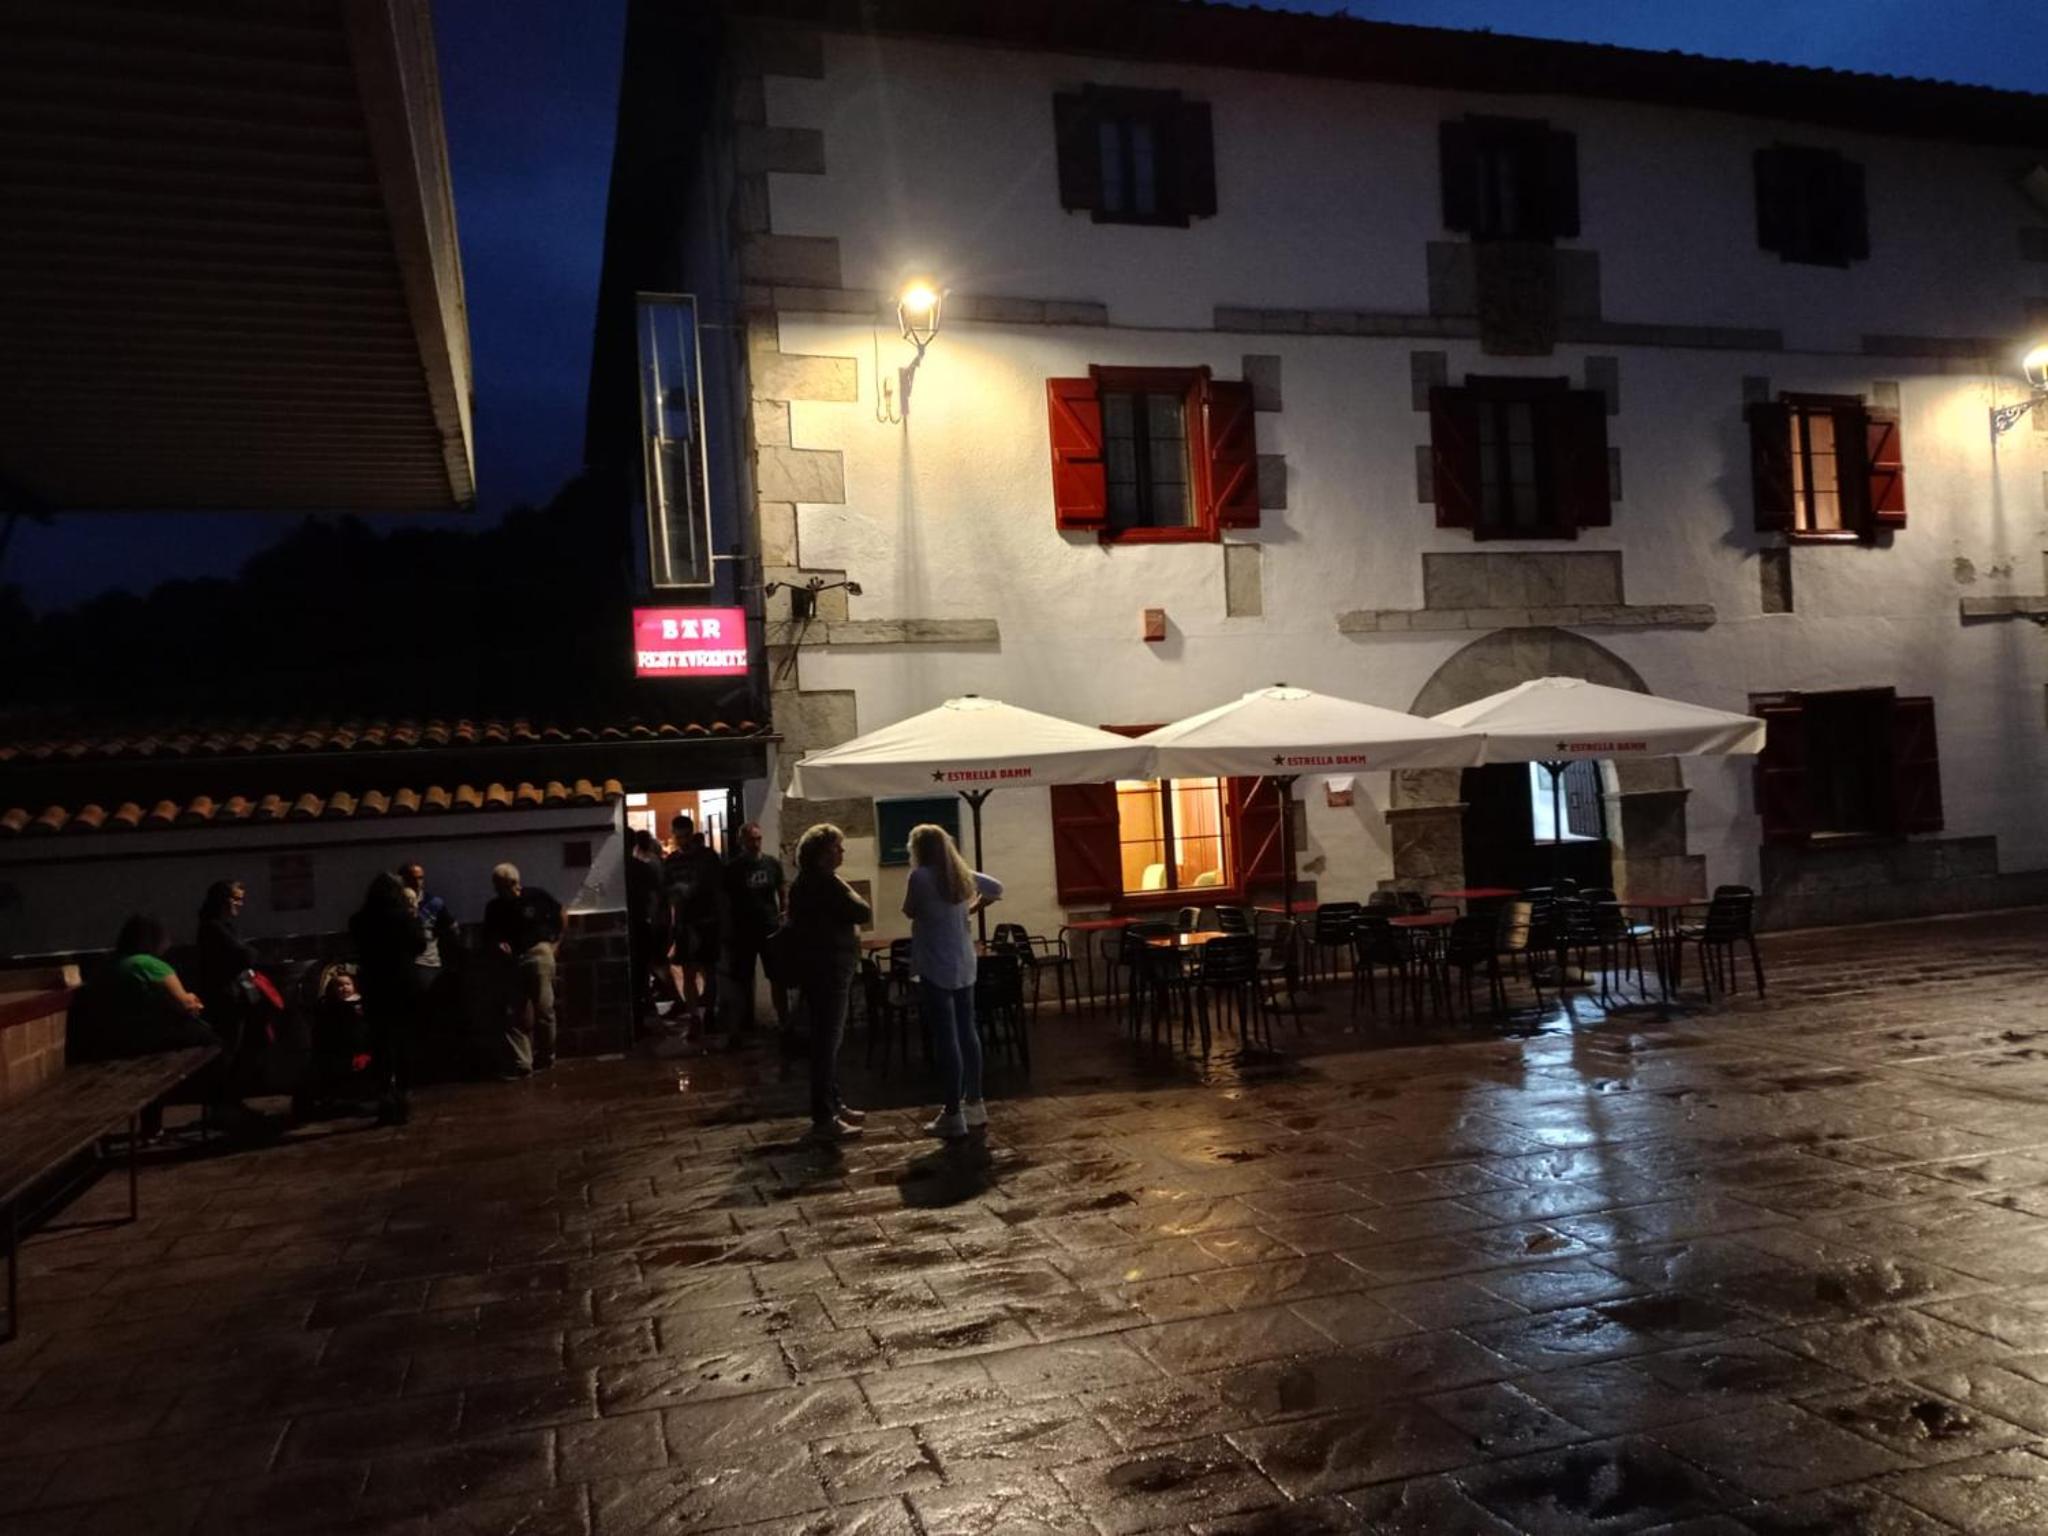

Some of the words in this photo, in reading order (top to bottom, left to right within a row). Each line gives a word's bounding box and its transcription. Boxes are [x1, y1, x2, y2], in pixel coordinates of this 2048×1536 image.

[661, 617, 721, 640] BAR
[1570, 742, 1615, 753] ESTRELLA
[1617, 742, 1647, 752] DAMM
[1287, 756, 1334, 766] ESTRELLA
[1336, 755, 1367, 765] DAMM
[947, 770, 997, 782] ESTRELLA
[1000, 767, 1031, 778] DAMM
